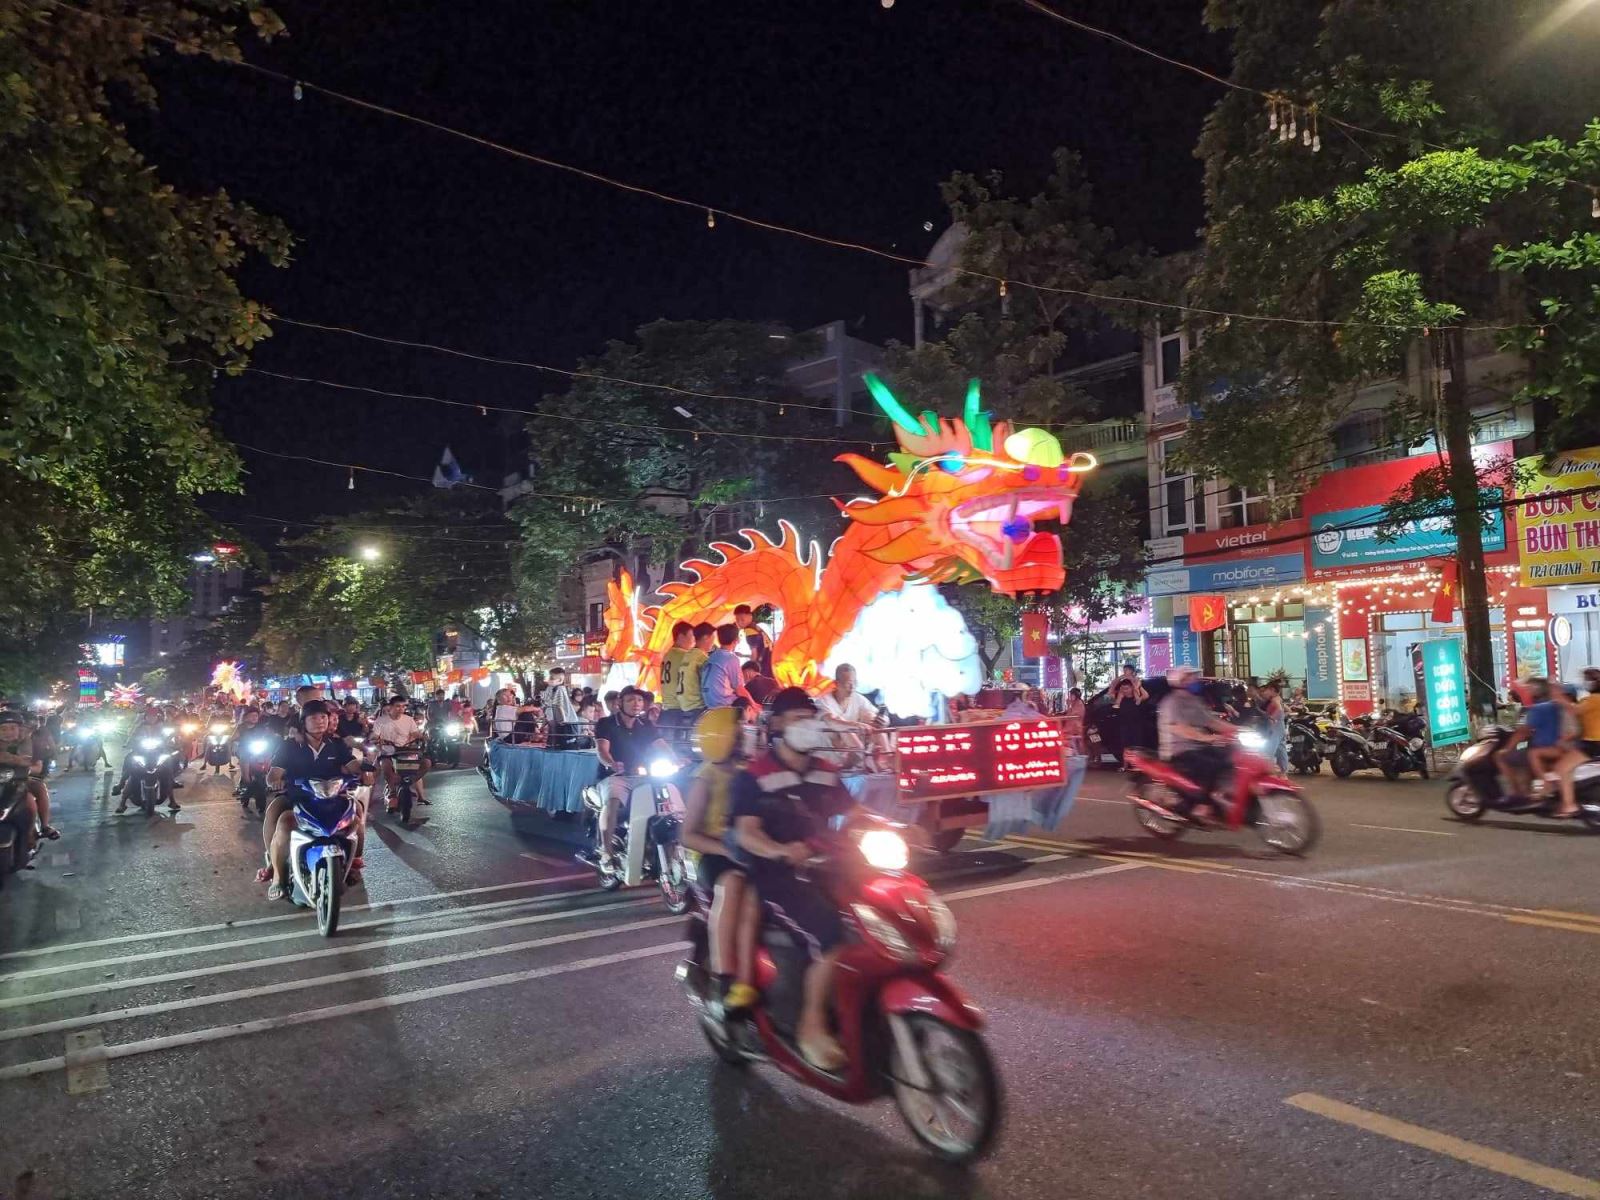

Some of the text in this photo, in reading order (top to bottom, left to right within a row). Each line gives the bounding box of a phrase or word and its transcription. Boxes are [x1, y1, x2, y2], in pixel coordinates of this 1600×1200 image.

[1524, 484, 1574, 517] BÚN
[1580, 490, 1600, 512] C
[1216, 531, 1266, 548] viettel
[1526, 520, 1600, 553] BÚN TH
[1213, 565, 1276, 581] mobifone
[1550, 562, 1582, 577] CHANH
[1316, 622, 1329, 682] vinaphone
